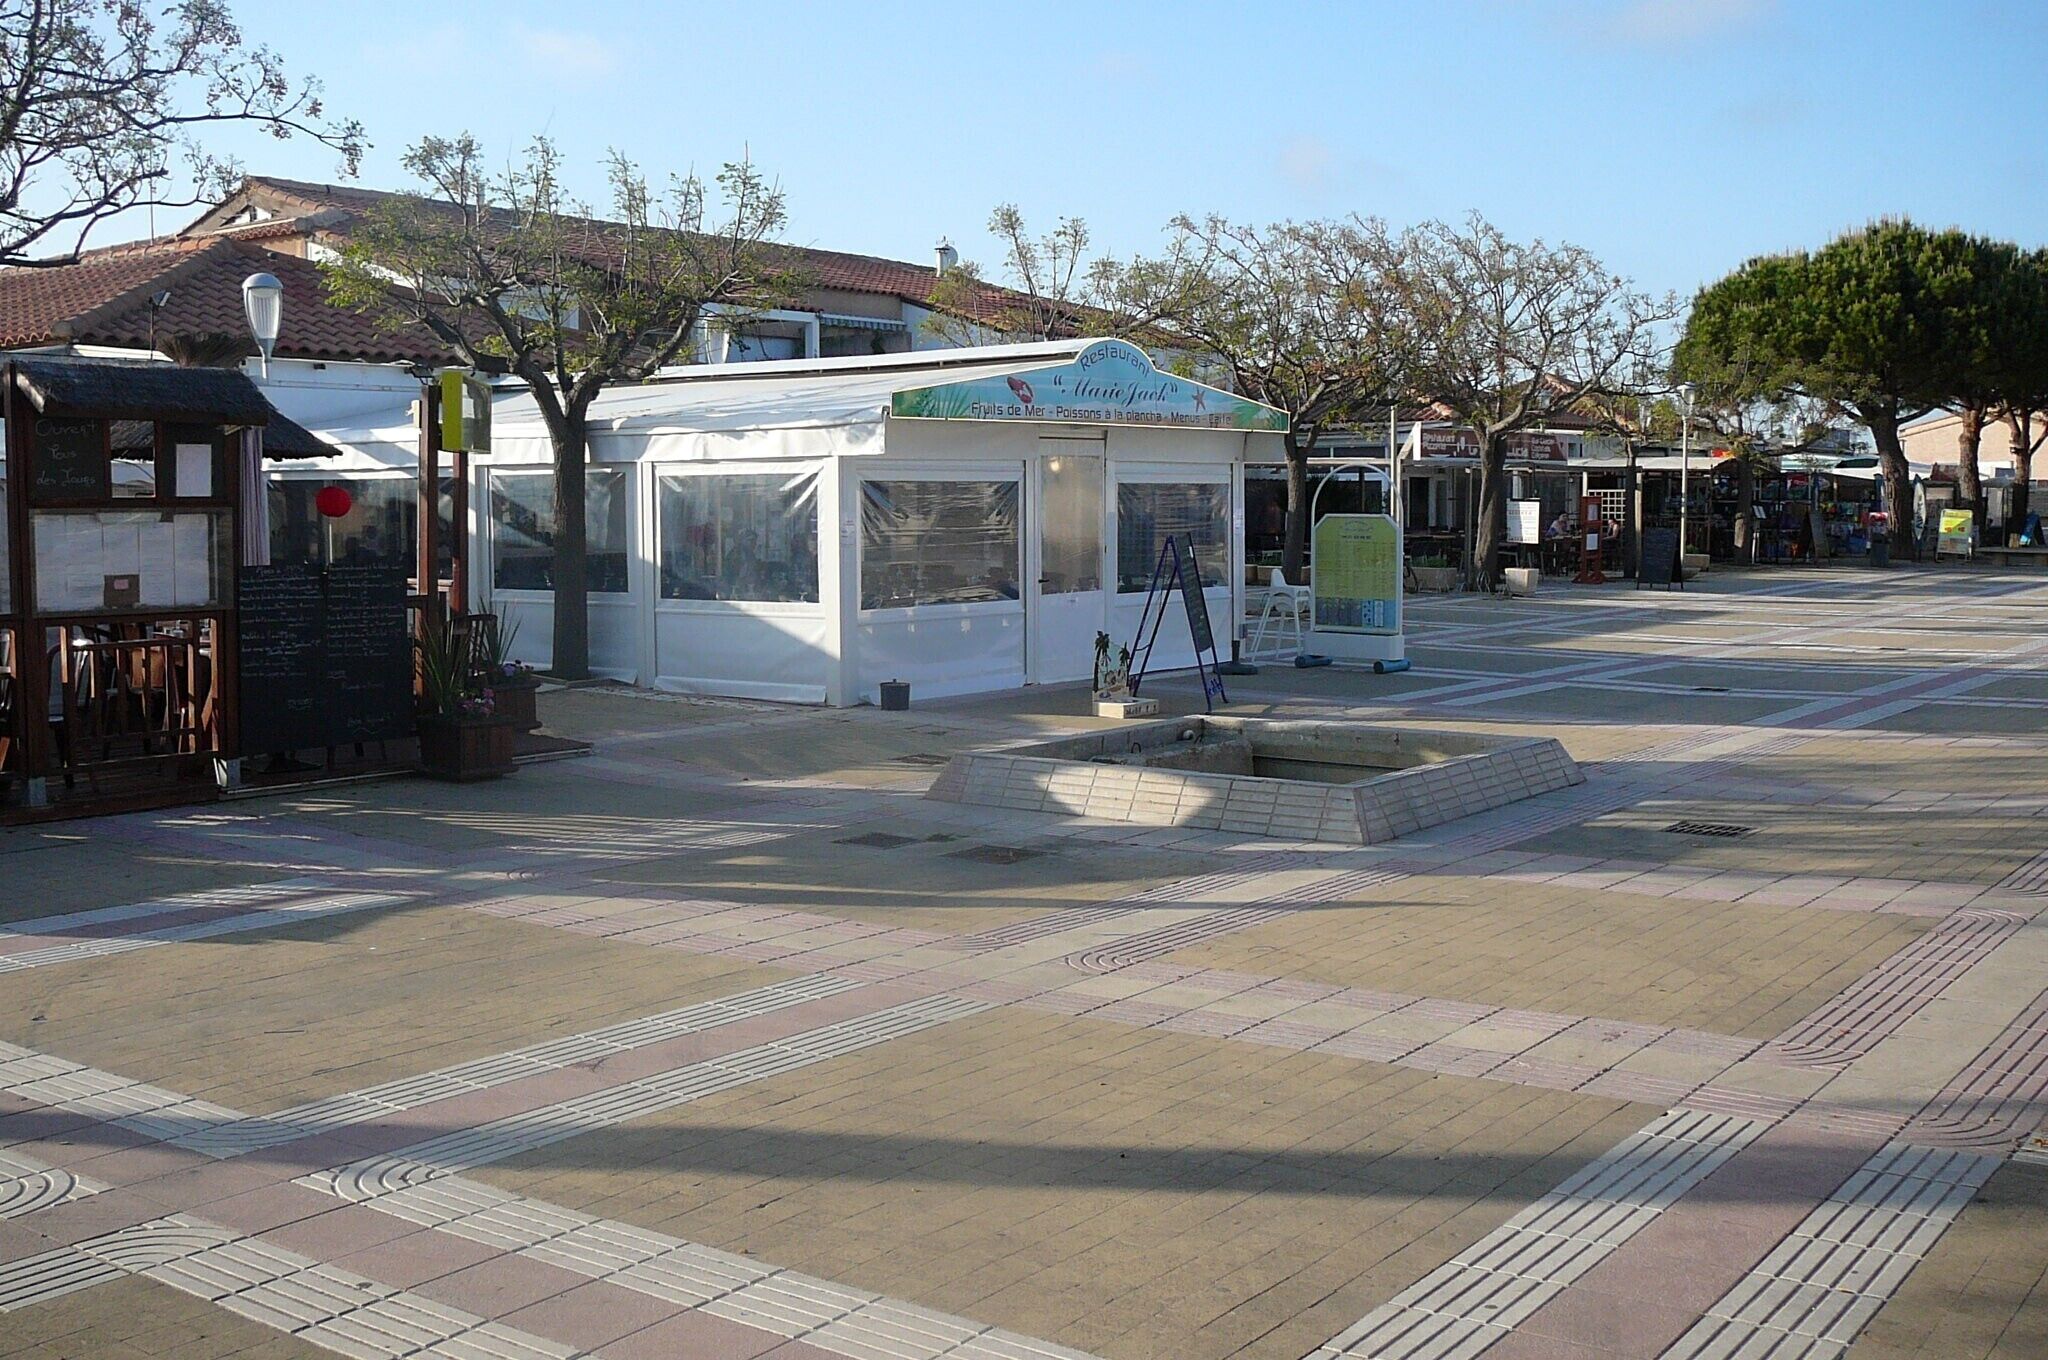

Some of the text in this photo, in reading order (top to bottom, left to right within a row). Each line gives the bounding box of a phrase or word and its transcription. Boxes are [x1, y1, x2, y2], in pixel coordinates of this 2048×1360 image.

[1080, 344, 1150, 378] Restaurant
[971, 402, 1003, 416] Fruits
[1007, 403, 1021, 416] de
[1025, 404, 1046, 417] Mer
[1056, 406, 1102, 419] Poissons
[1105, 408, 1111, 420] à
[1114, 408, 1123, 420] la
[1126, 409, 1162, 423] plancha
[1171, 411, 1200, 424] Menus
